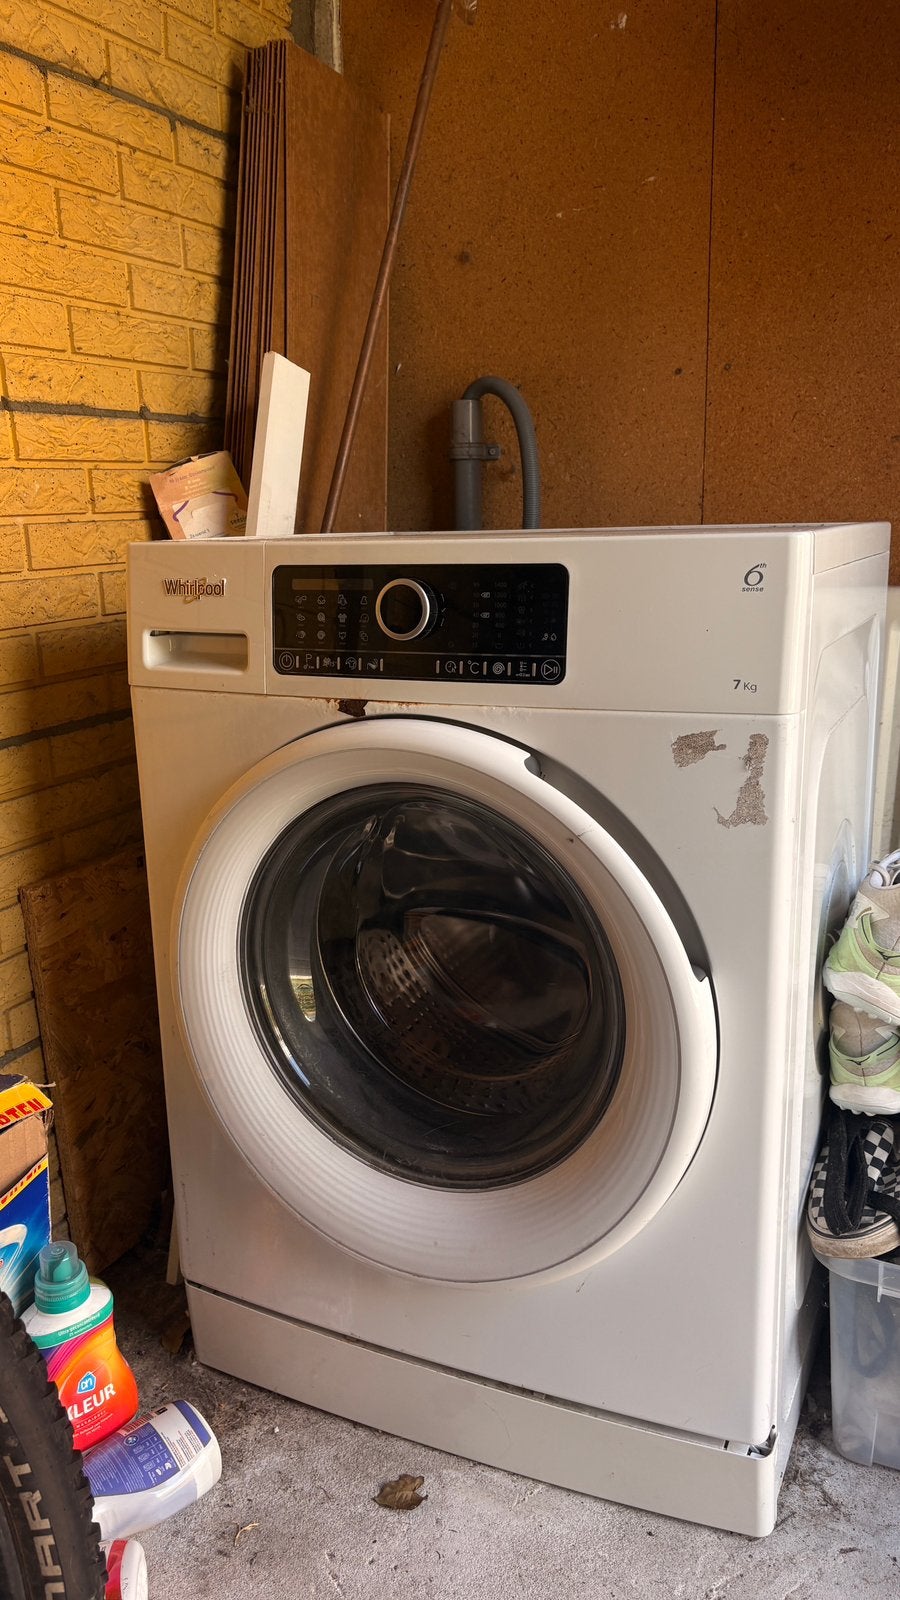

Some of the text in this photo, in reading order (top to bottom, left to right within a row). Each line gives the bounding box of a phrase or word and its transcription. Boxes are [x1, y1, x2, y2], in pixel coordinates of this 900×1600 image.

[163, 578, 226, 600] Whirlpool
[733, 679, 758, 693] 7 Kg
